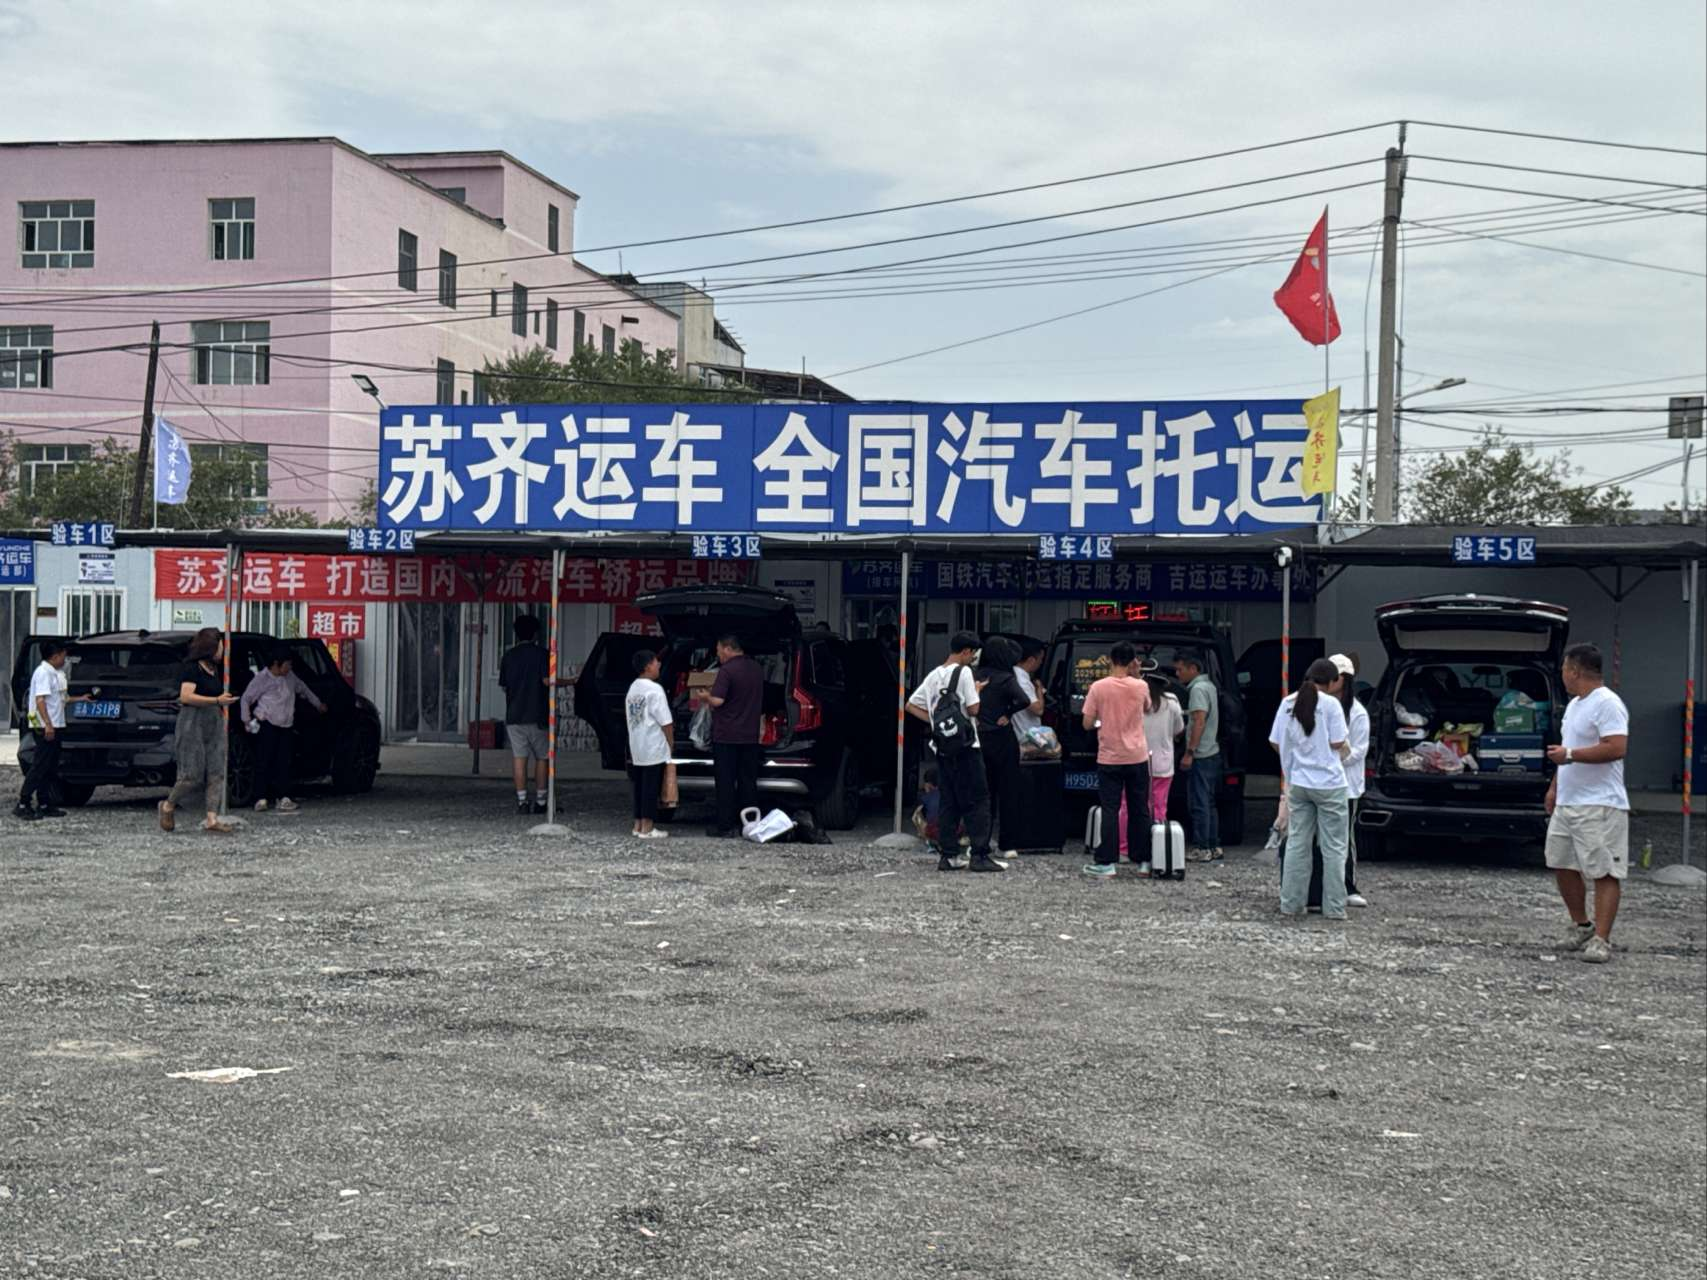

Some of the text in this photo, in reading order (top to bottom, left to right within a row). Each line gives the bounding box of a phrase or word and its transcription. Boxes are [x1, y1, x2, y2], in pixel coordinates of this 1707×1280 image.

[381, 408, 1321, 528] 苏齐运车 全国汽车托运
[52, 524, 115, 545] 验车1区
[350, 529, 414, 550] 验车2区
[693, 535, 760, 557] 验车3区
[1040, 536, 1112, 558] 验车4区
[1454, 537, 1535, 560] 验车5区
[176, 557, 305, 596] 苏齐运车
[312, 611, 362, 636] 超市
